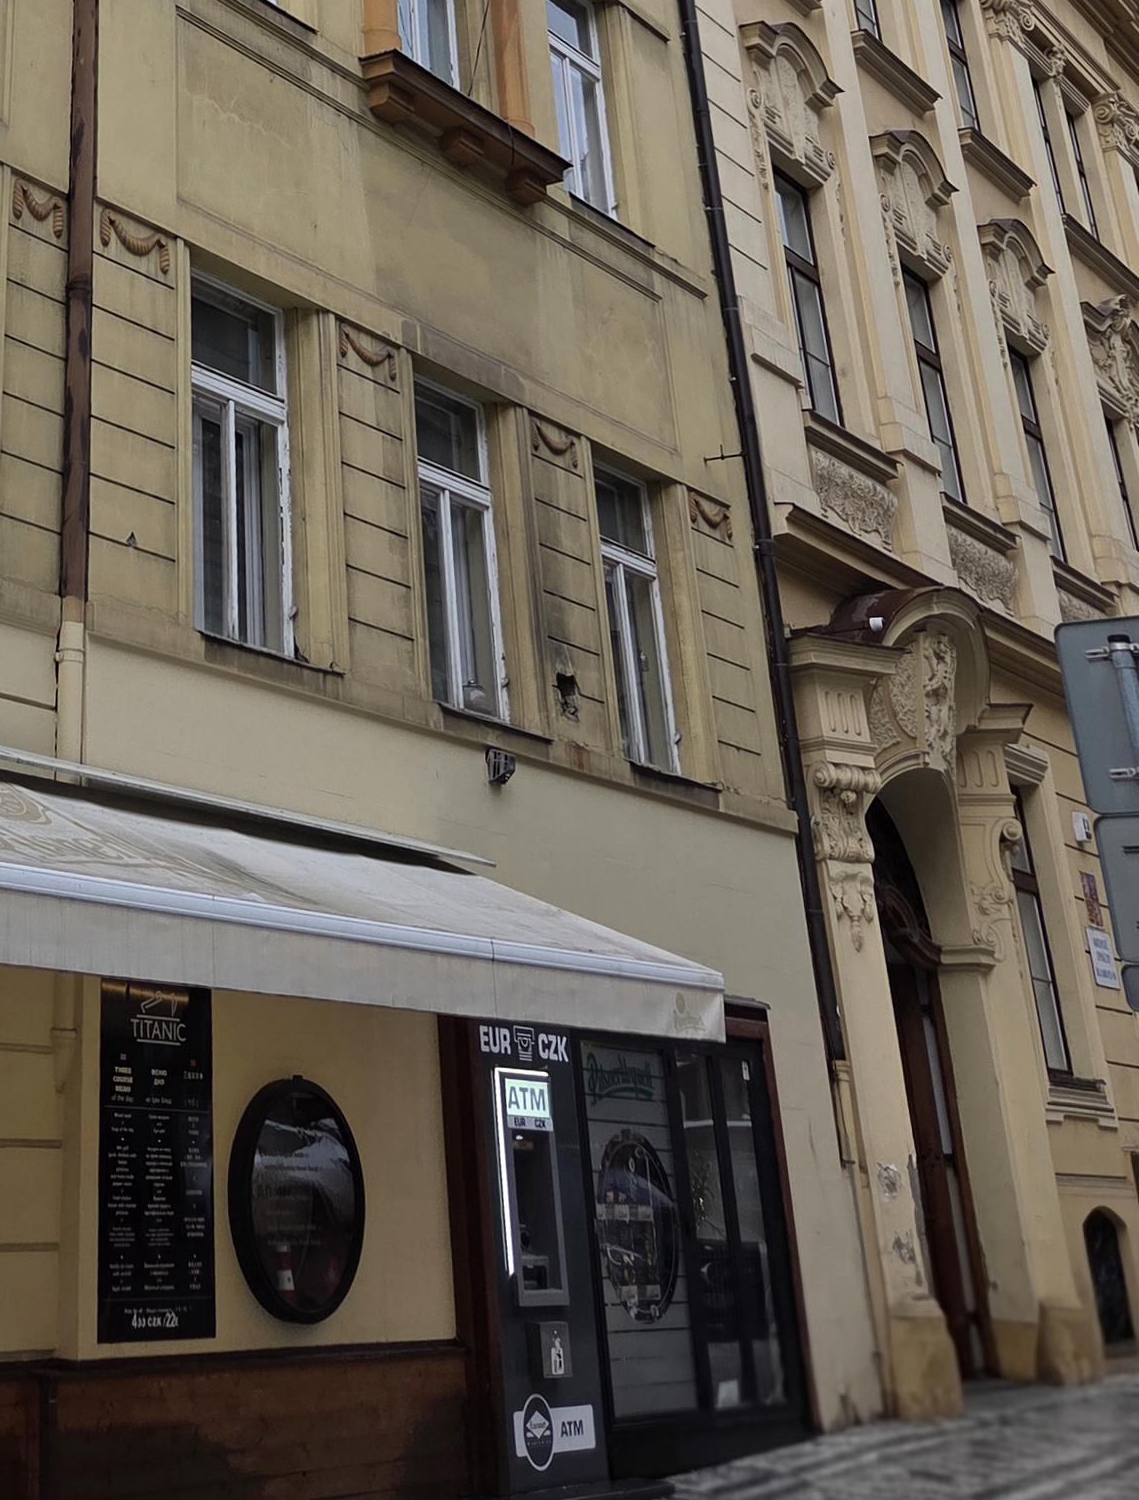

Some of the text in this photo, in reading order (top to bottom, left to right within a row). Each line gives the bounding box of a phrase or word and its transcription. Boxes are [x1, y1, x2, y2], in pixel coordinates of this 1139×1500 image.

[130, 1018, 186, 1042] TITANIC
[479, 1024, 569, 1063] EUR CZK
[508, 1085, 547, 1112] ATM
[513, 1117, 547, 1129] EUR CZK
[560, 1419, 584, 1438] ATM
